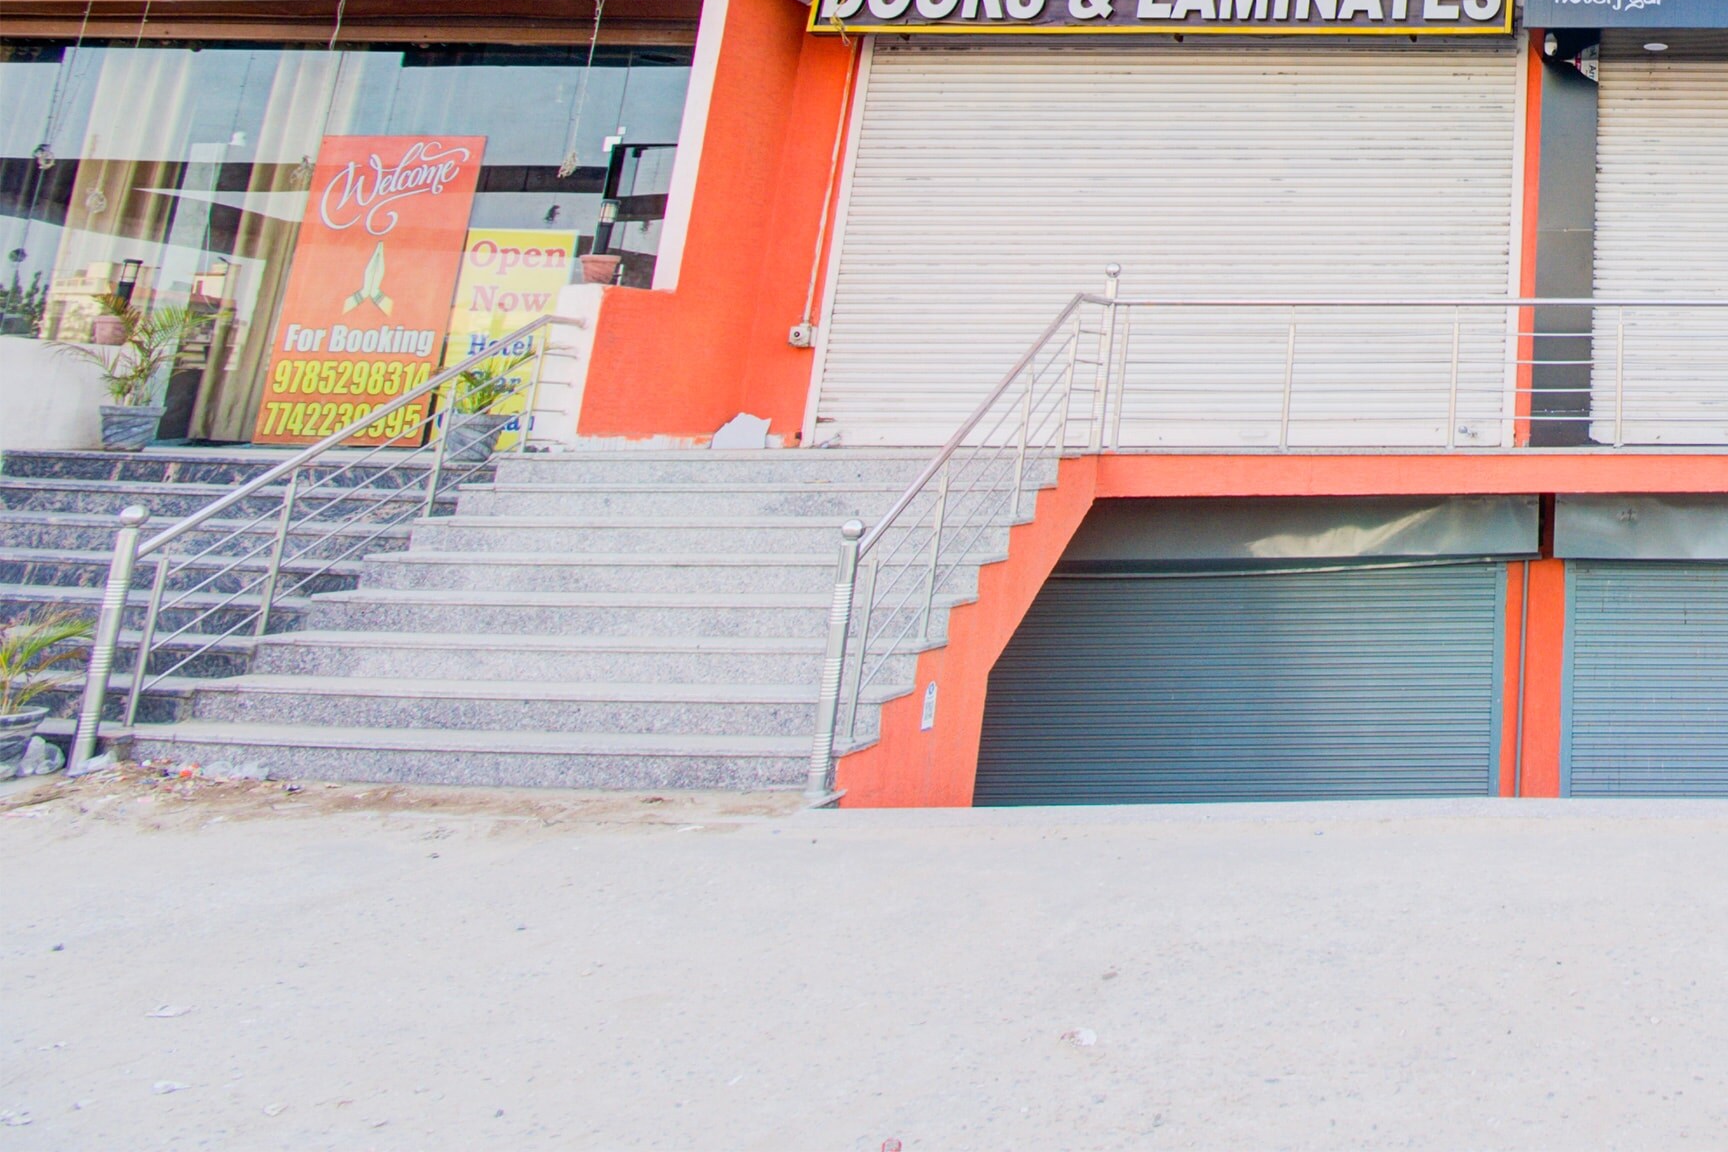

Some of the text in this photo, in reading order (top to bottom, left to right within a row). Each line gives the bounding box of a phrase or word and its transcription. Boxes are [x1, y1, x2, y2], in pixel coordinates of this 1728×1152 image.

[320, 141, 470, 236] Welcome
[469, 240, 566, 275] Open
[469, 284, 551, 312] Now
[283, 324, 436, 357] For Booking
[272, 359, 431, 395] 9785298314
